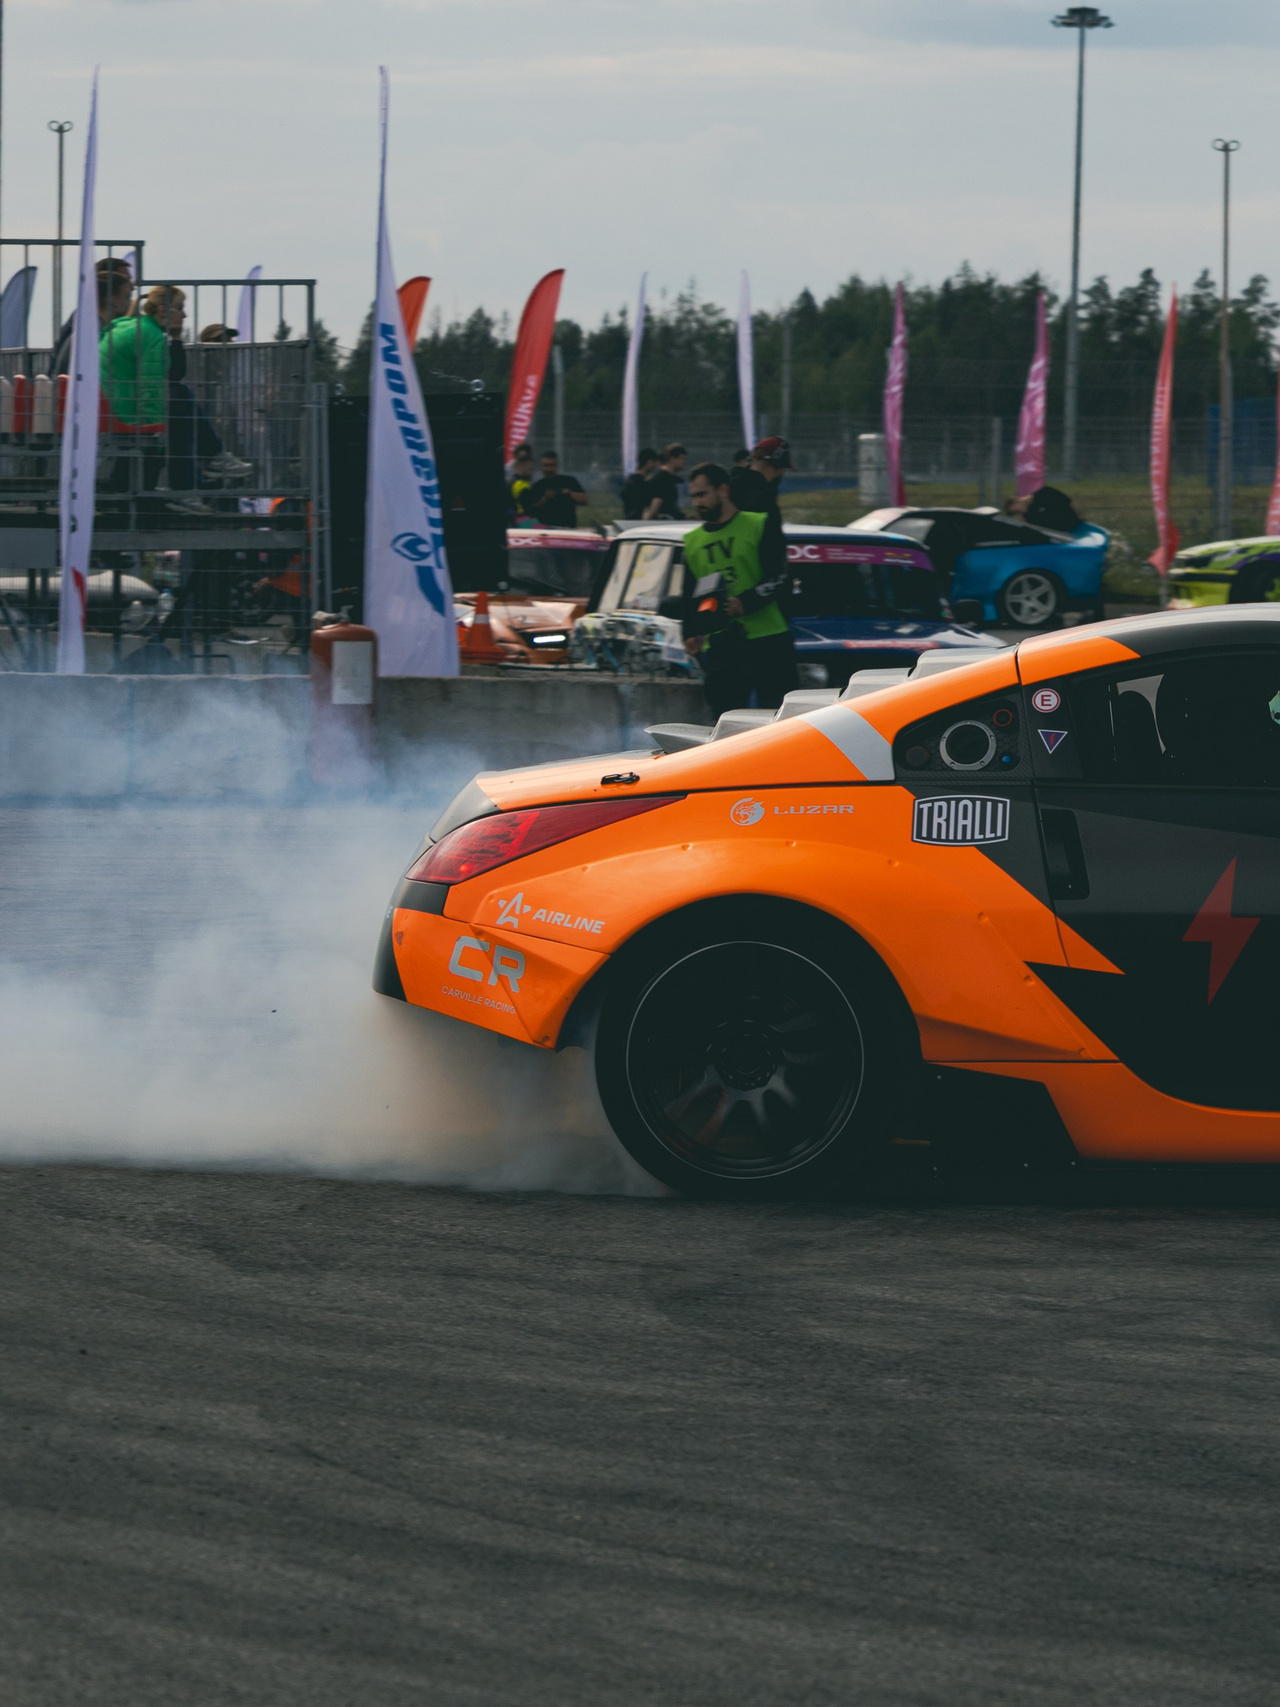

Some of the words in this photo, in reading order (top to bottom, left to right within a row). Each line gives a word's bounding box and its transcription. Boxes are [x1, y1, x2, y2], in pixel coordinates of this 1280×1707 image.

[703, 536, 735, 564] TV
[1040, 694, 1052, 707] E
[773, 804, 855, 815] LUZAR
[919, 799, 1004, 840] TRIALLI
[532, 908, 606, 934] AIRLINE
[448, 935, 526, 994] CR
[441, 985, 483, 1006] CARVILLE
[483, 997, 517, 1015] RACING
